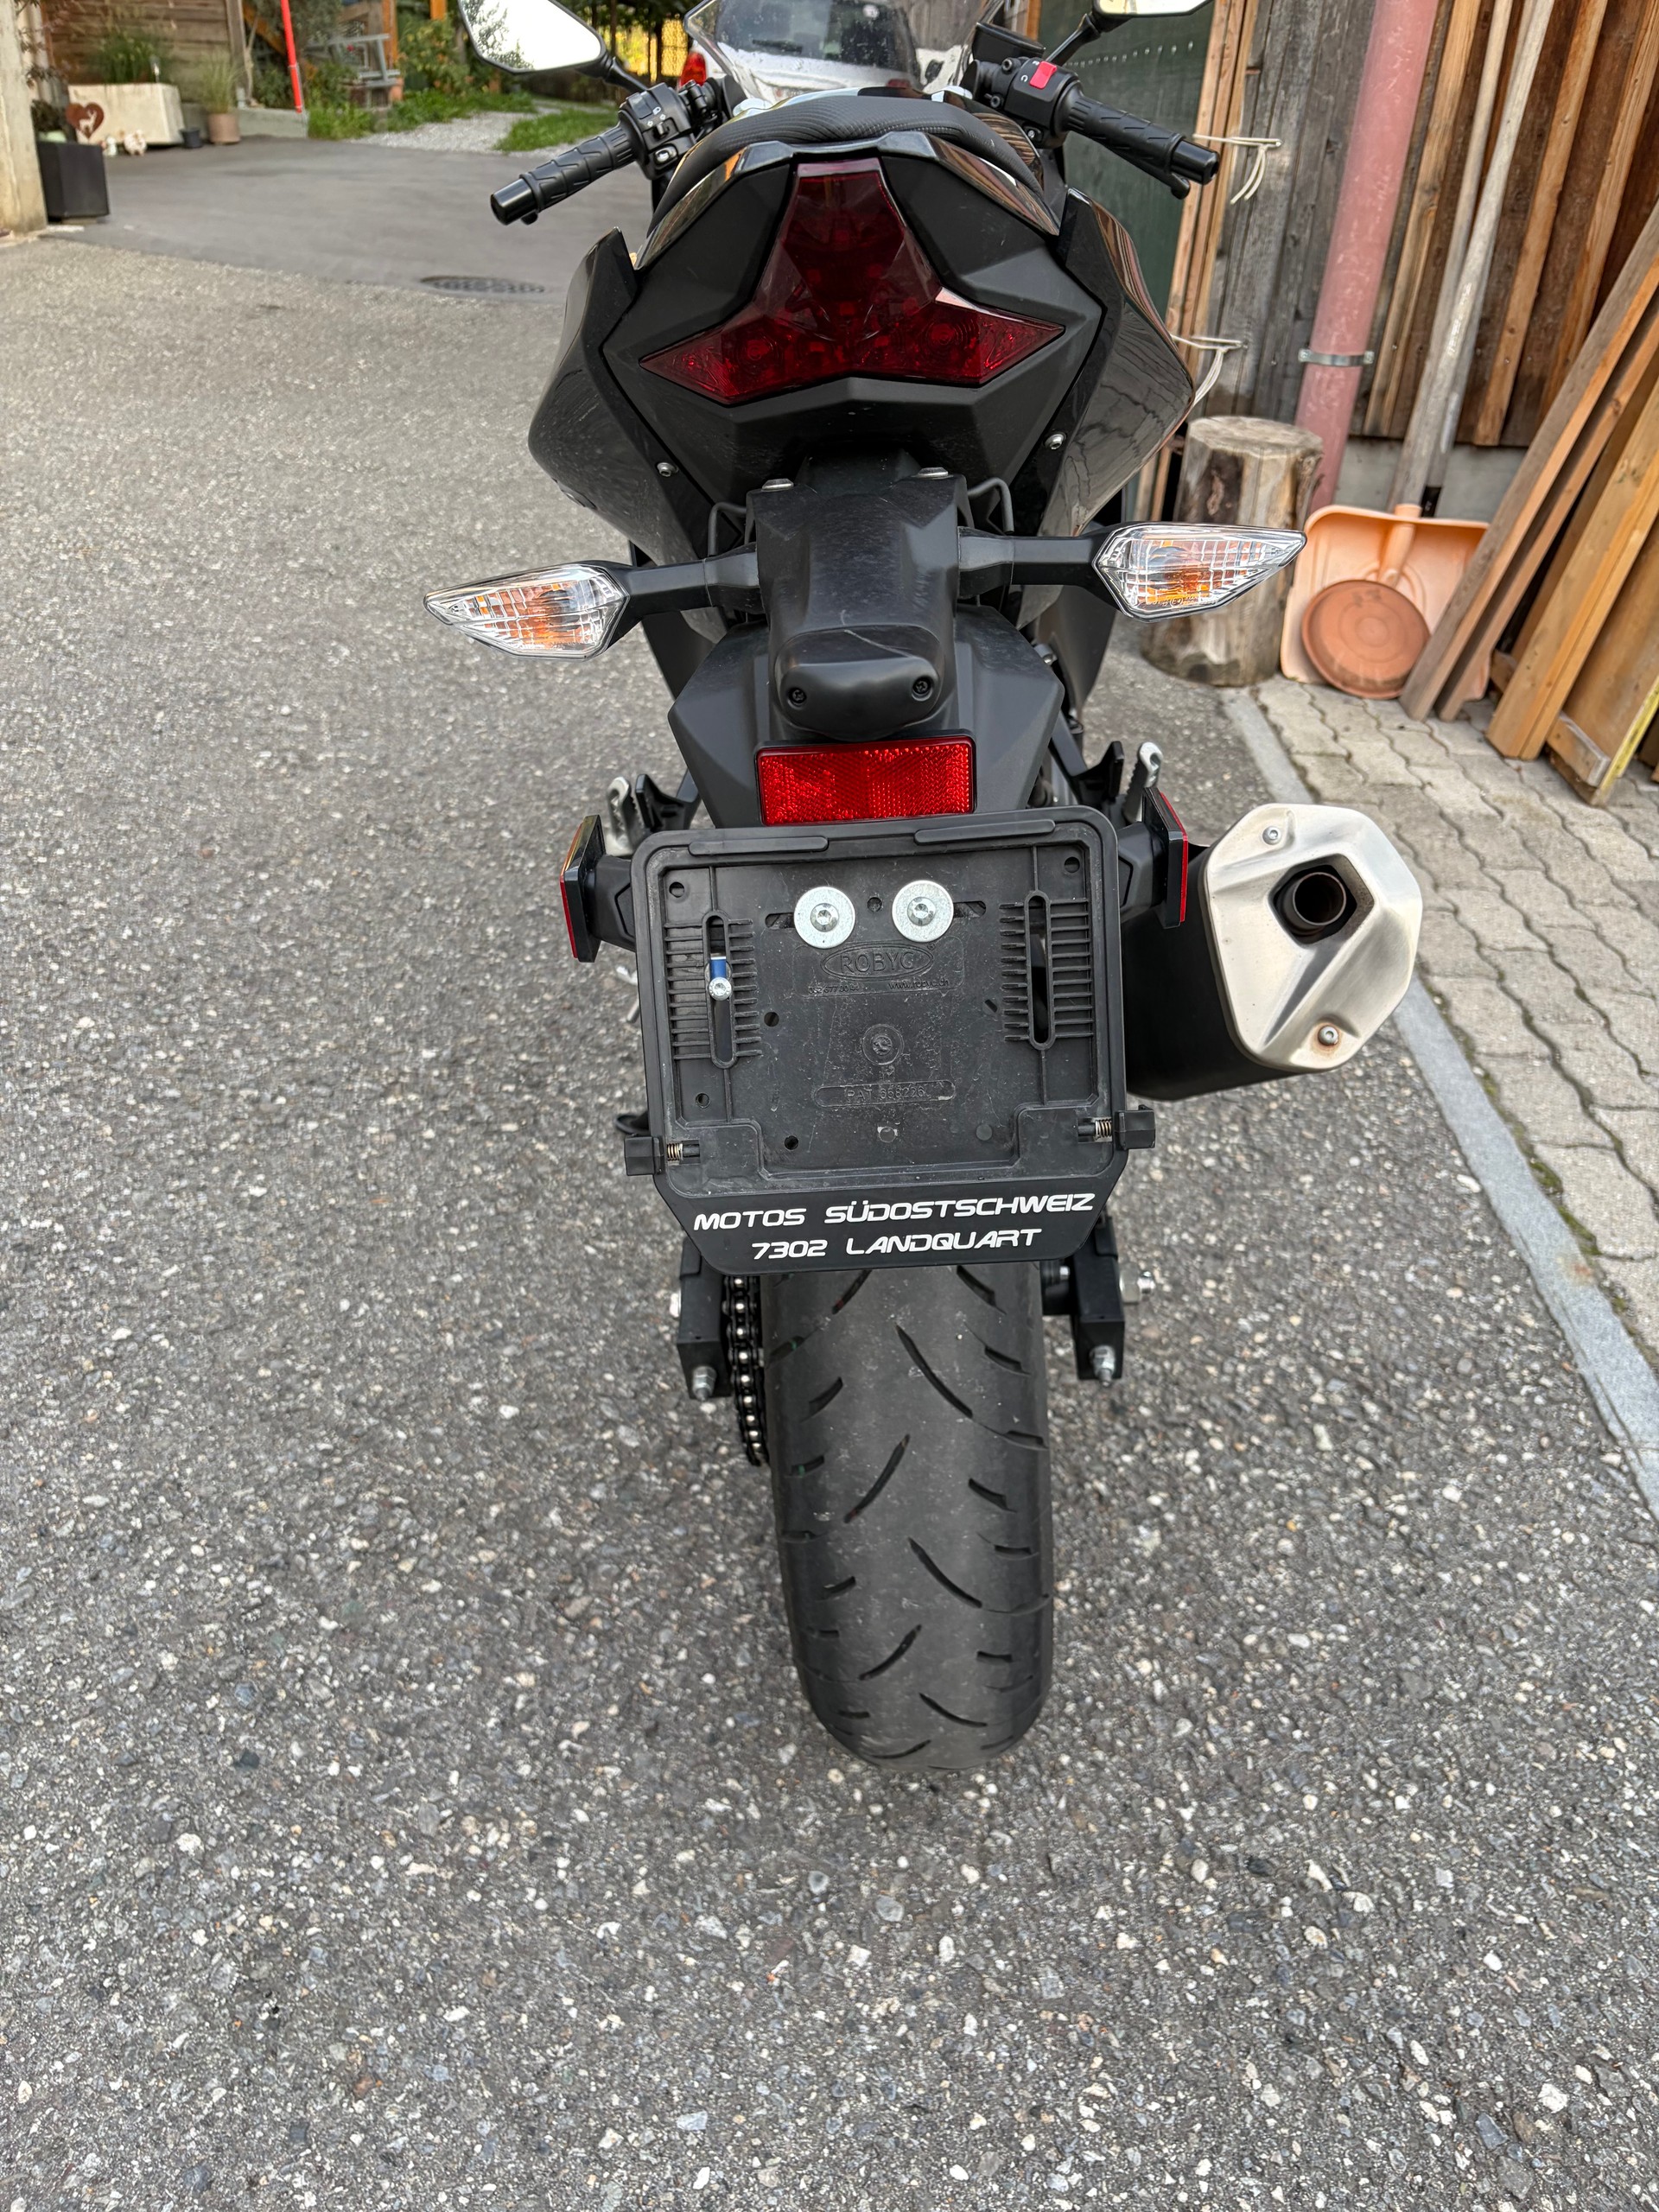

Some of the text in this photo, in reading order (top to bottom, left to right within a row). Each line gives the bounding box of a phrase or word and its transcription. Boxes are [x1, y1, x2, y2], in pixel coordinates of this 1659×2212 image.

[840, 951, 914, 974] ROBYG
[693, 1192, 1096, 1231] MOTOS SÜDOSTSCHWEIZ
[751, 1228, 1043, 1261] 7302 LANDQUART
